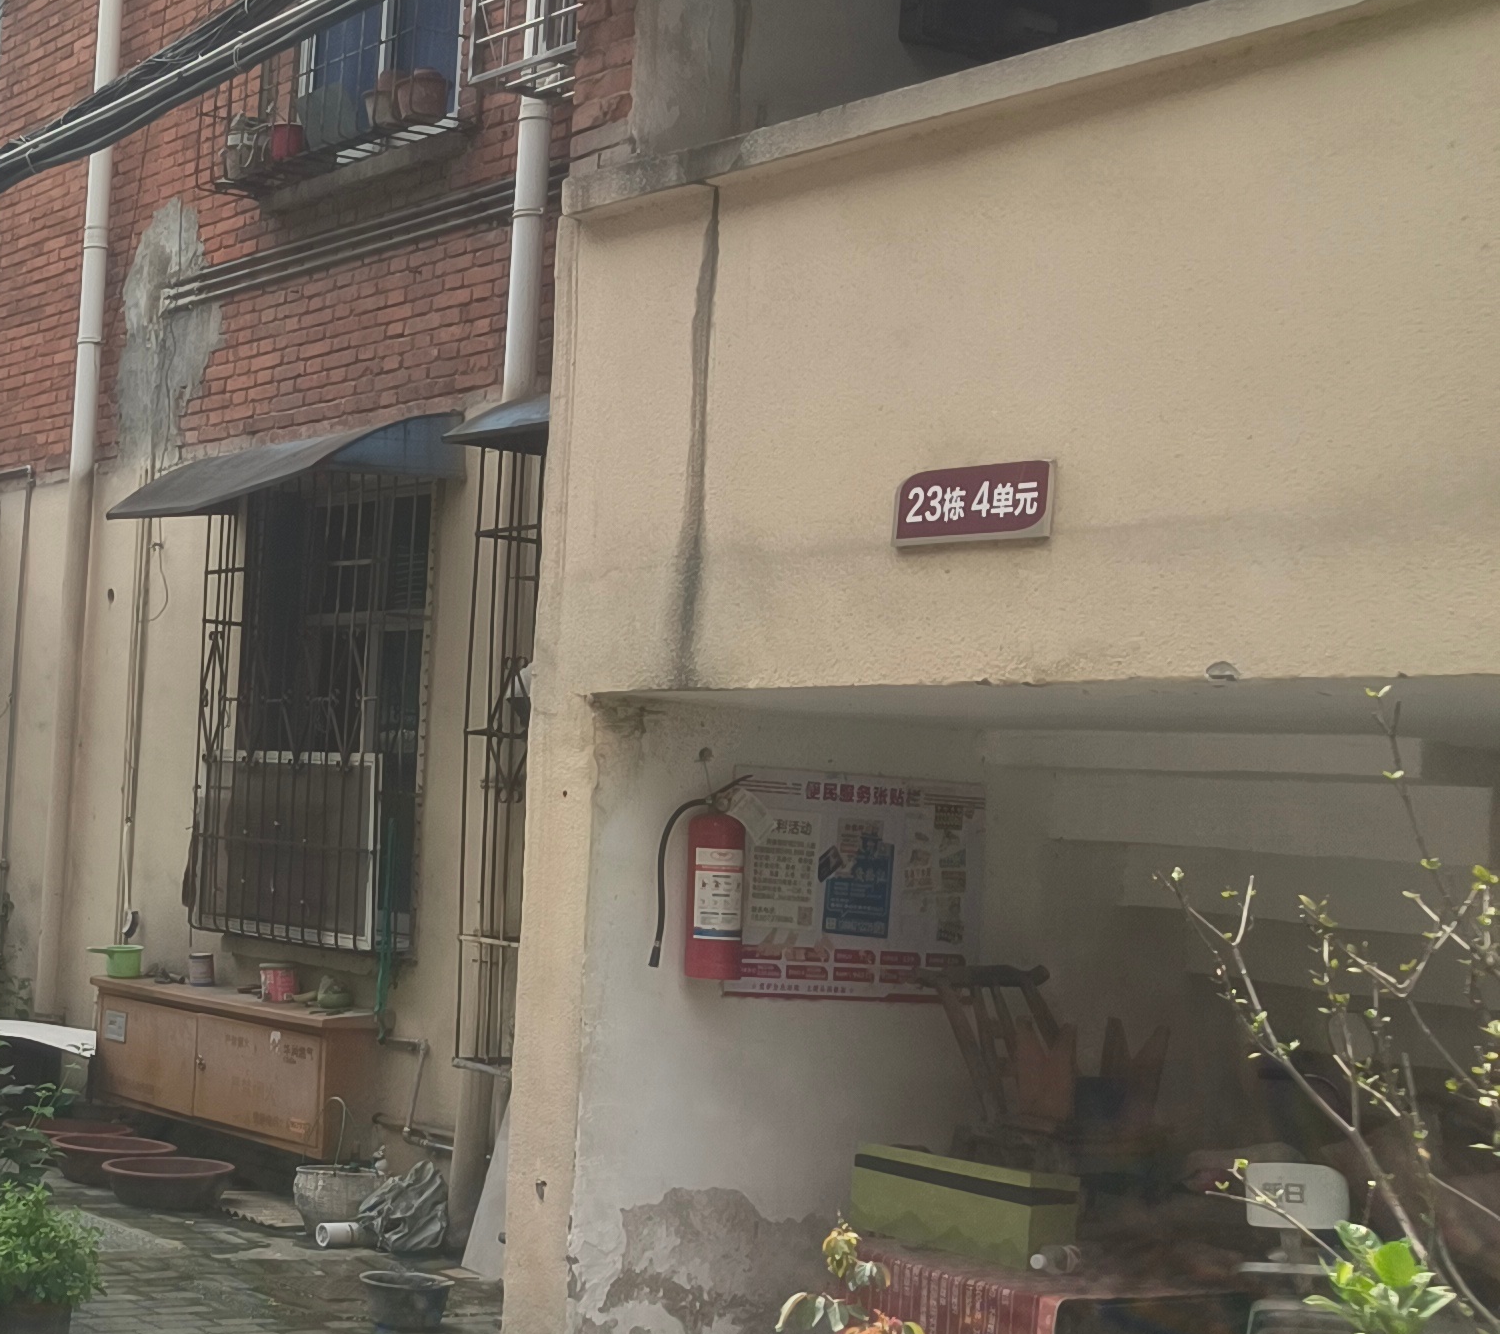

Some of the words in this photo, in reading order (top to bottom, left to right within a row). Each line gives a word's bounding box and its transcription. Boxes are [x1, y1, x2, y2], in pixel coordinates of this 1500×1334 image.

[905, 485, 967, 523] 23栋
[971, 480, 1039, 517] 4单元
[805, 780, 922, 808] 便民服务张贴栏
